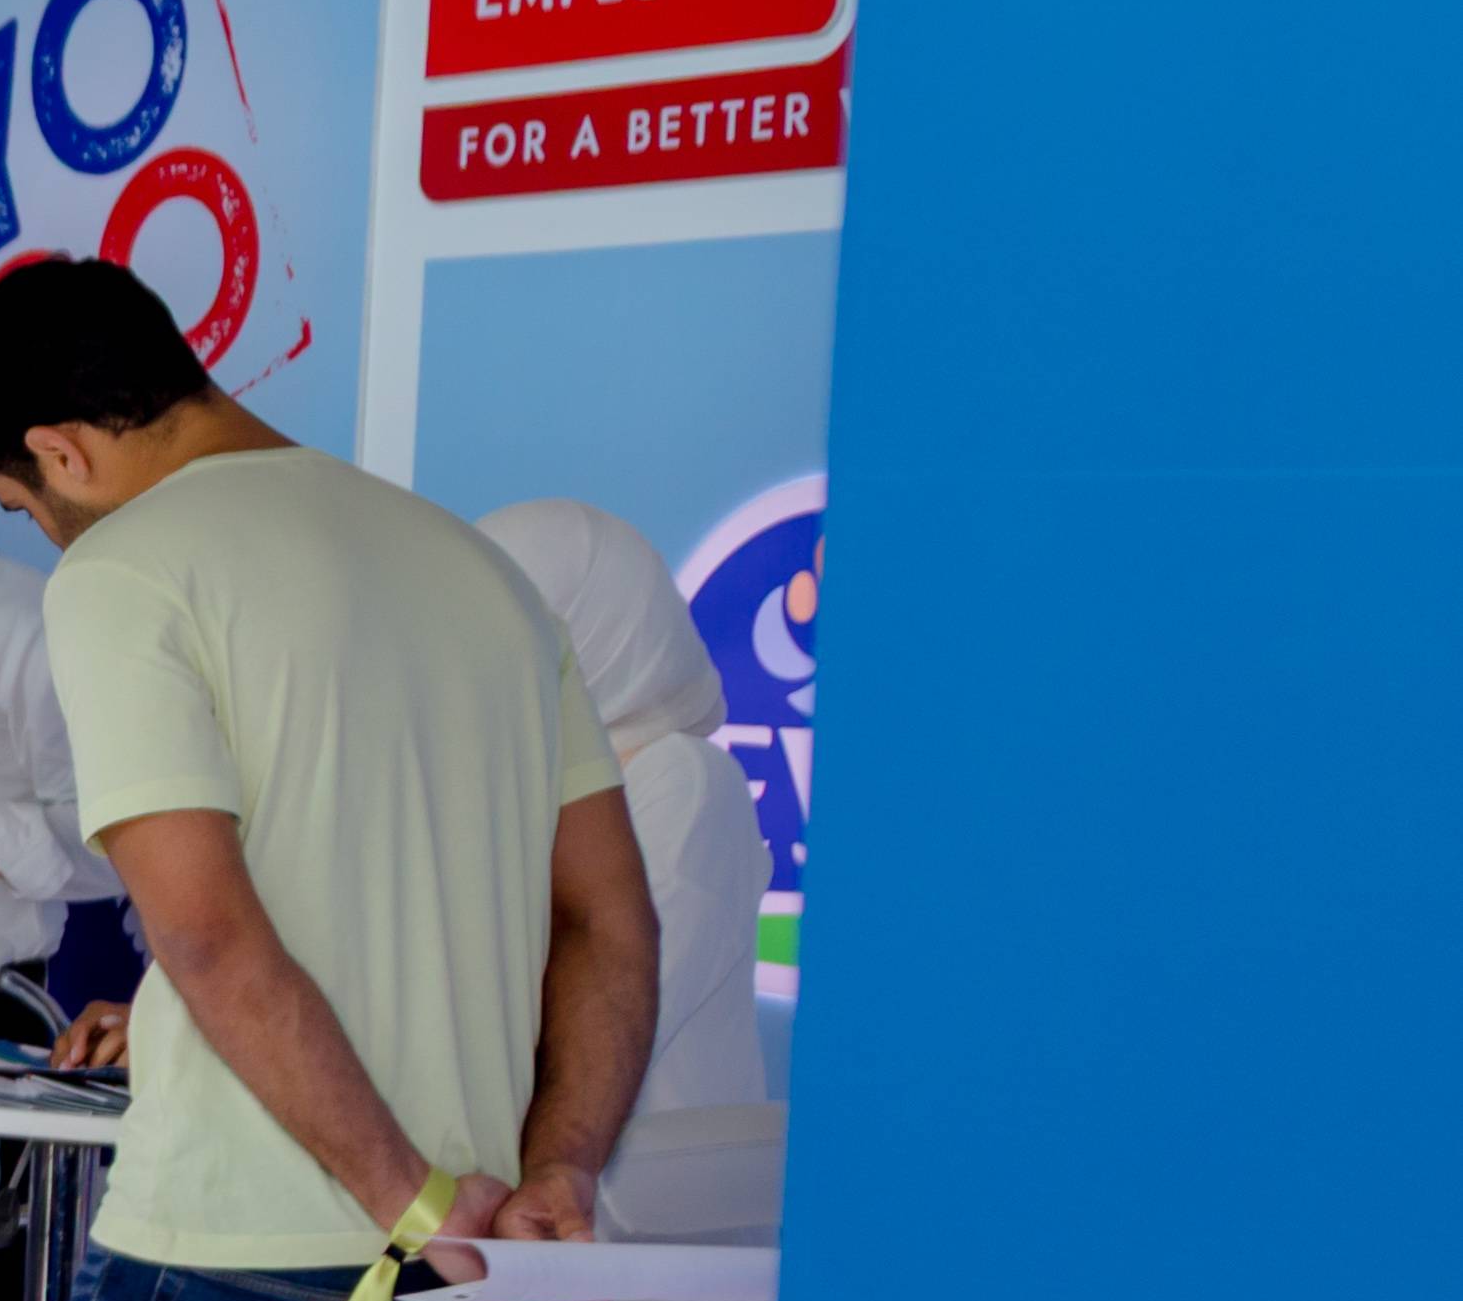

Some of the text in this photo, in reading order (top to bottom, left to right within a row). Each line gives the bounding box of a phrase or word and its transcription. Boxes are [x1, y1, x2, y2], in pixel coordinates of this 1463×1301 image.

[457, 118, 547, 170] FOR
[570, 113, 601, 159] A
[626, 91, 811, 155] BETTER
